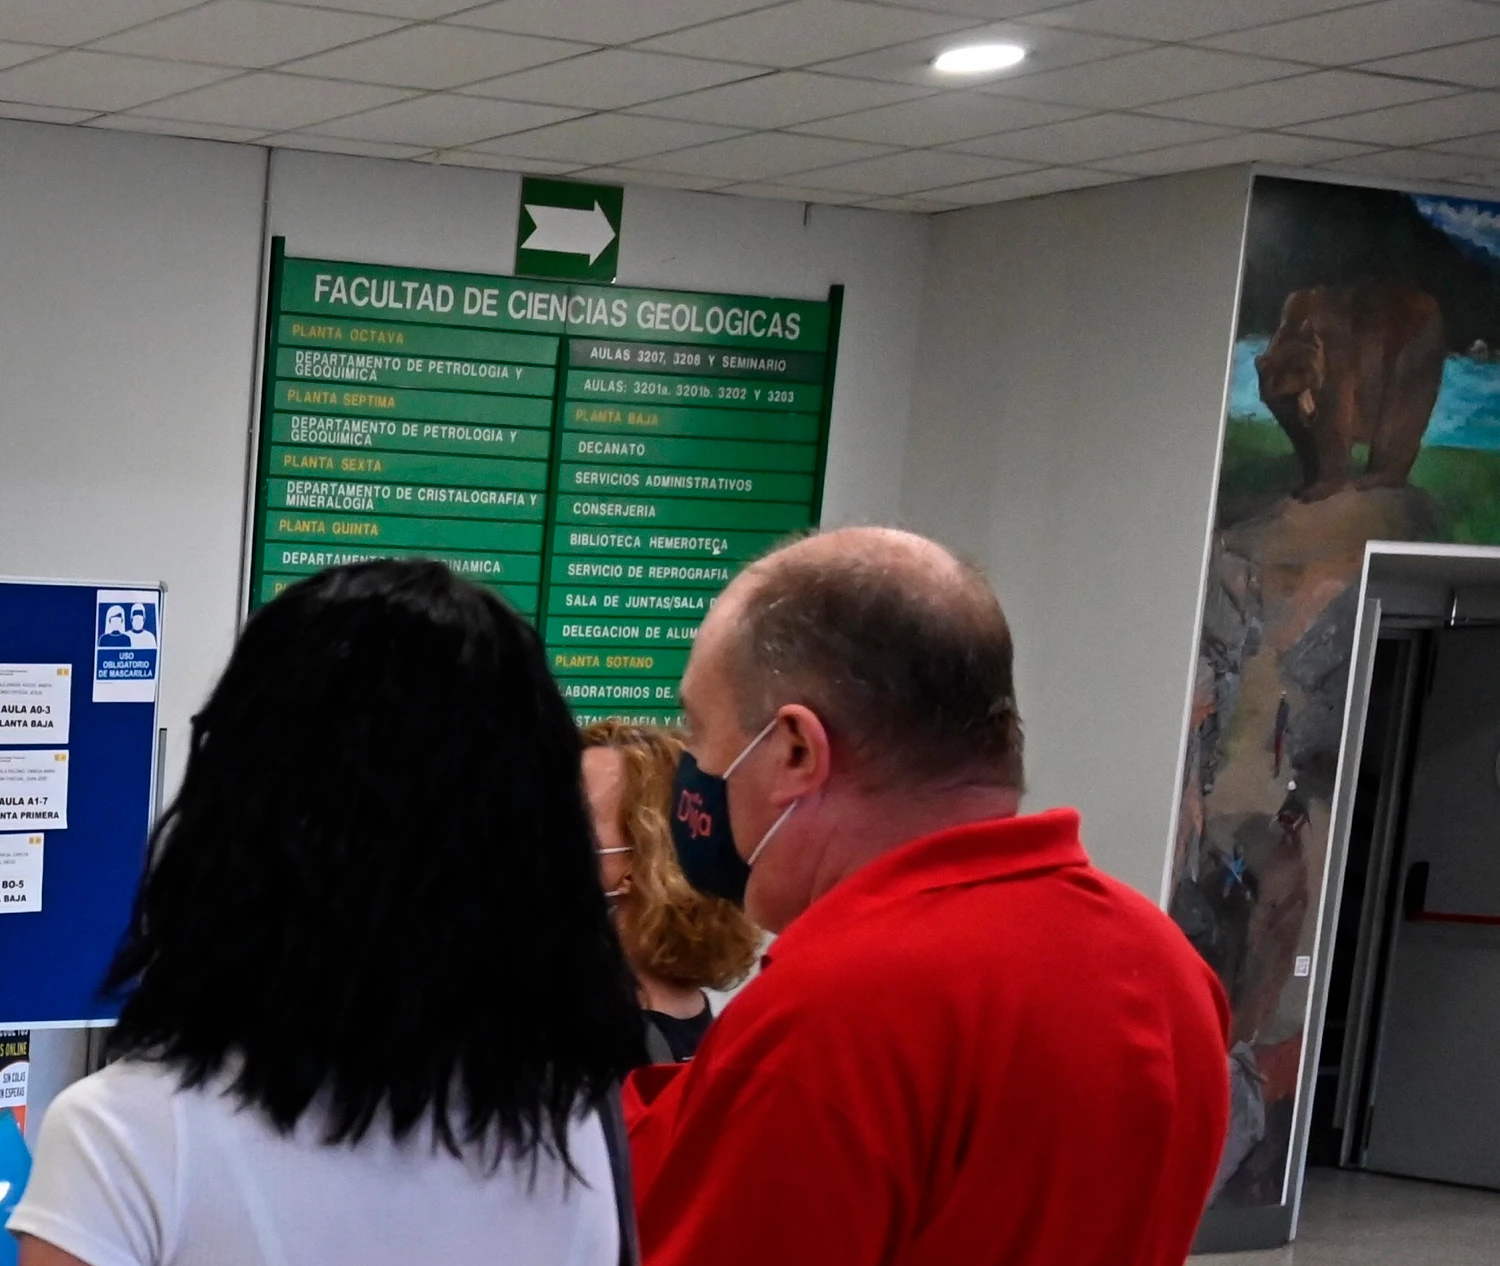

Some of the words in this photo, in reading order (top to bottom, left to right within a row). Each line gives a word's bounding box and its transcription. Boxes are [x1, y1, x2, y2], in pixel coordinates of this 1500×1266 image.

[314, 275, 454, 313] FACULTAD
[464, 287, 498, 316] DE
[508, 291, 627, 328] CIENCIAS
[636, 301, 800, 340] GEOLOGICAS
[591, 348, 631, 361] AULAS
[708, 354, 715, 366] Y
[722, 355, 786, 371] SEMINARIO
[579, 442, 645, 456] DECANATO
[284, 455, 335, 469] PLANTA
[342, 458, 382, 472] SEXTA
[576, 472, 639, 486] SERVICIOS
[646, 475, 752, 491] ADMINISTRATIVOS
[286, 493, 374, 510] MINERALOGIA
[287, 481, 391, 501] DEPARTAMENTO
[396, 484, 414, 499] DE
[418, 488, 525, 505] CRISTALOGRAFIA
[530, 495, 537, 505] Y
[574, 503, 656, 517] CONSERJERIA
[570, 534, 641, 547] BIBLIOTECA
[650, 537, 728, 552] HEMEROTECA
[568, 564, 622, 578] SERVICIO
[627, 566, 642, 578] DE
[649, 567, 728, 579] REPROGRAFIA
[556, 656, 600, 667] PLANTA
[606, 655, 654, 669] SOTANO
[6, 1042, 27, 1056] ONLINE
